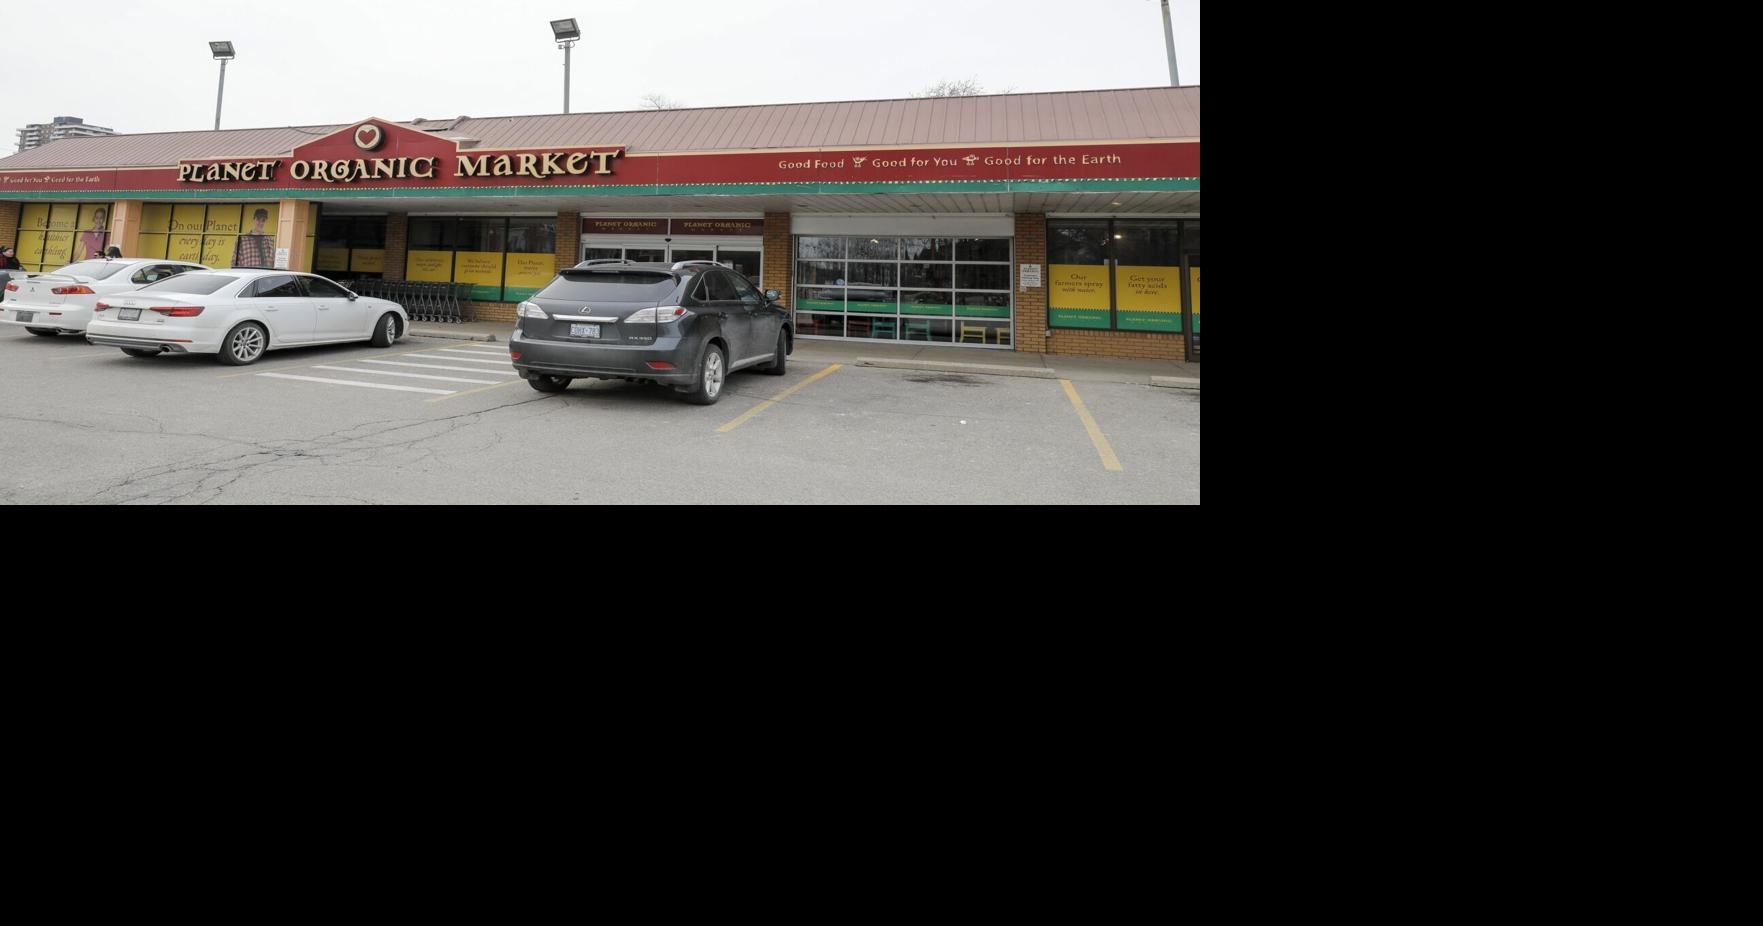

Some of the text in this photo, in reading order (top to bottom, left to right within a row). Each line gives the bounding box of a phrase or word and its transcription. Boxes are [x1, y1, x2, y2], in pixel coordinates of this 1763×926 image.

[176, 149, 620, 183] PLANET ORGANIC MARKET
[778, 153, 1121, 169] Good Food Good for You Good for the Earth
[85, 175, 100, 183] Earth
[36, 217, 69, 228] Beome
[206, 219, 238, 231] Planet
